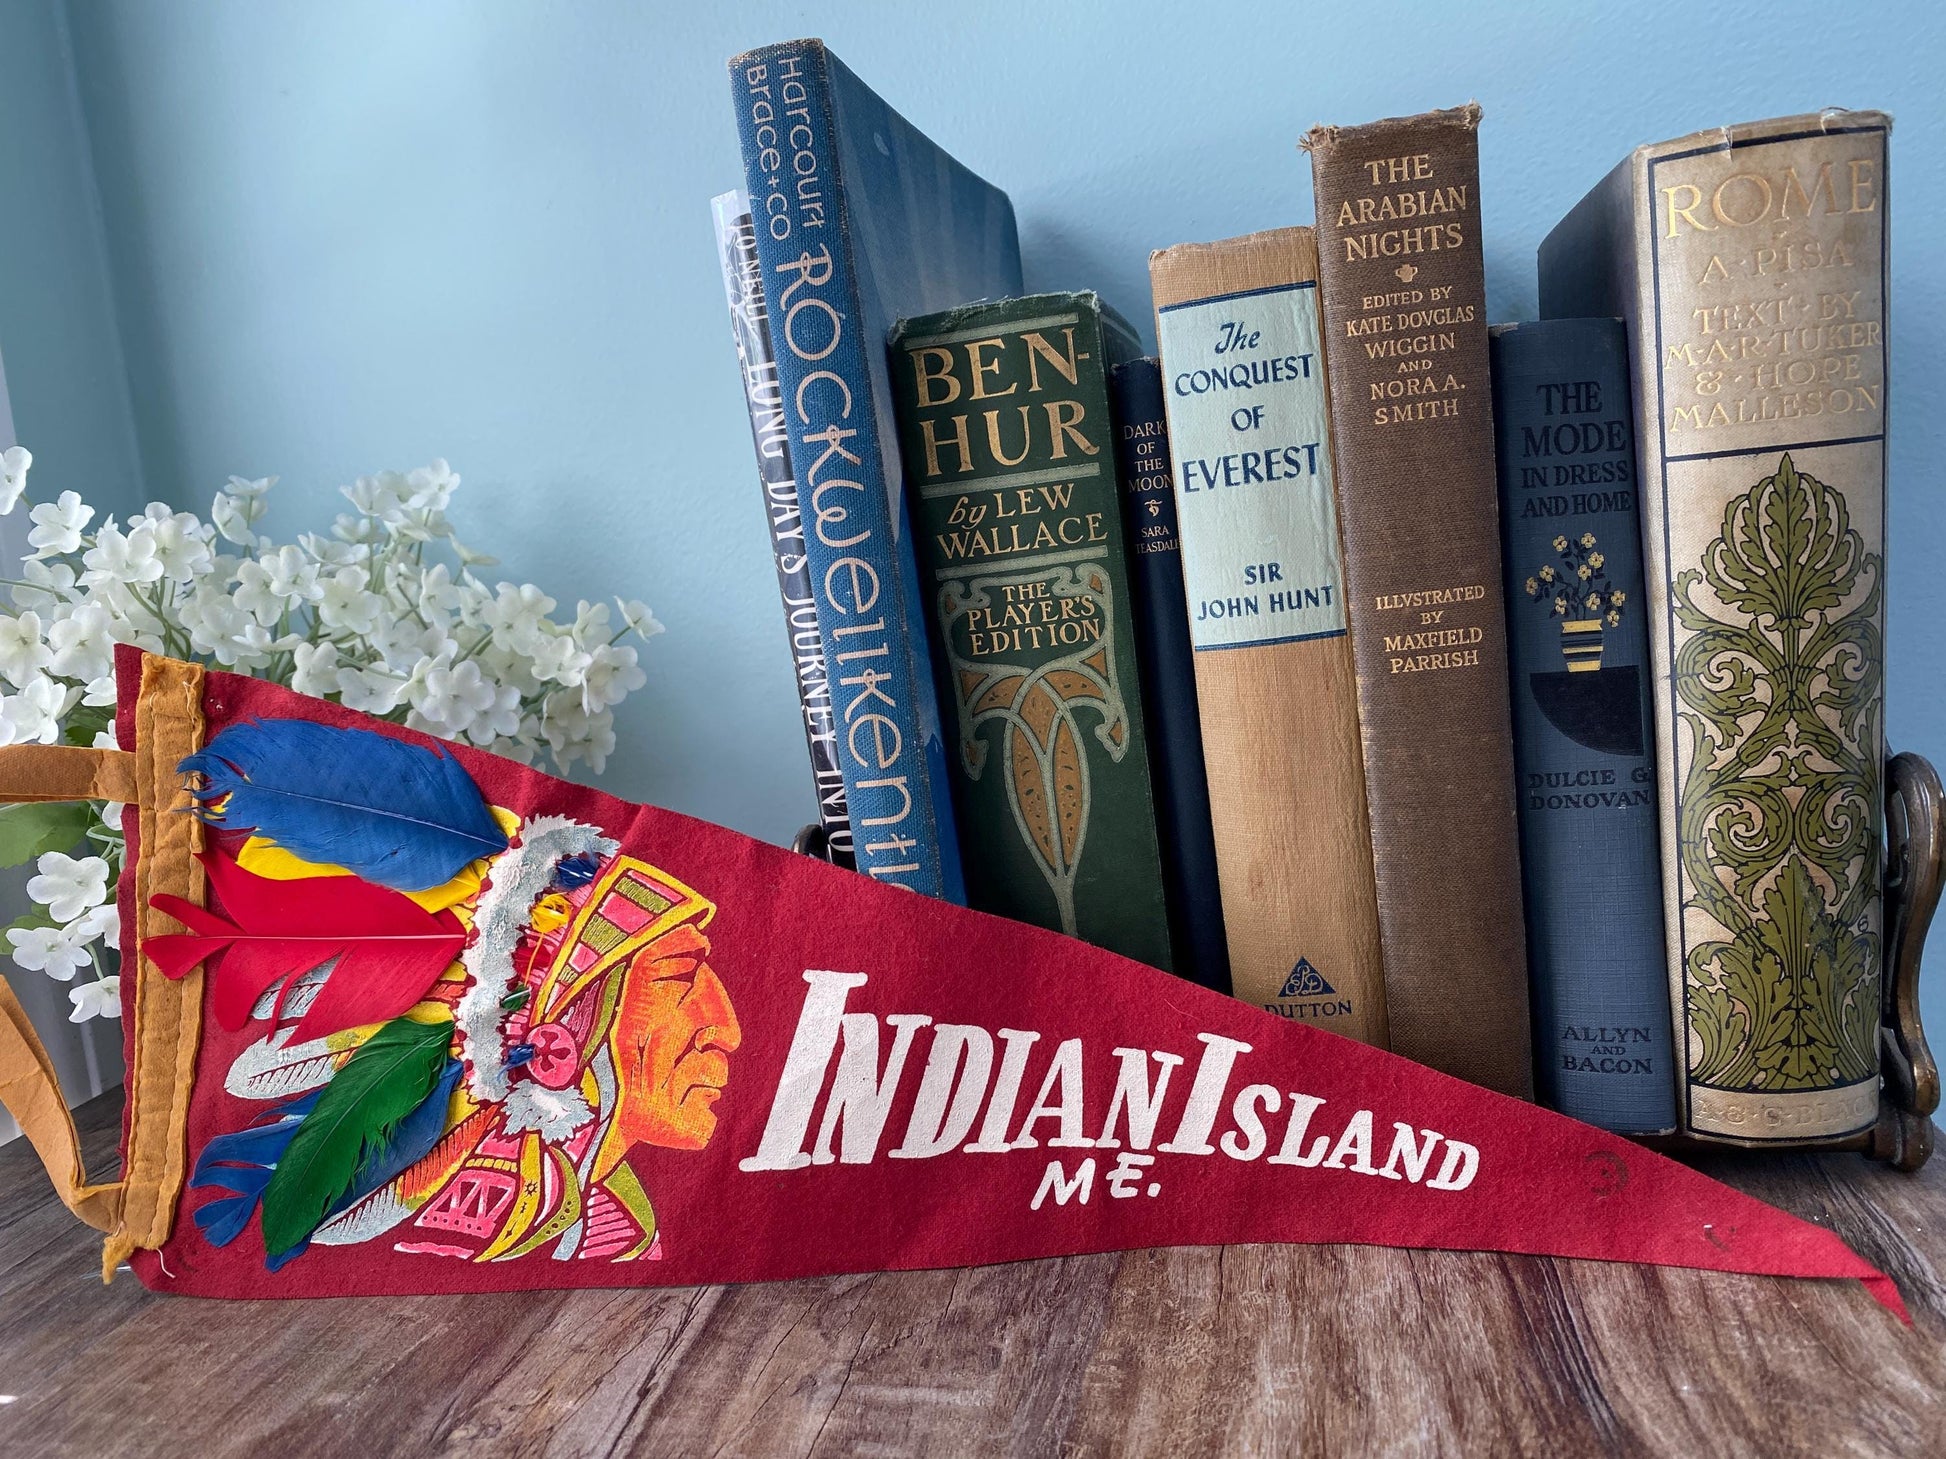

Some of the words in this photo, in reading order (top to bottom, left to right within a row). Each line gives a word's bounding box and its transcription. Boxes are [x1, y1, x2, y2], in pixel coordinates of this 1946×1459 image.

[778, 56, 825, 228] Harcourt
[1364, 153, 1434, 186] THE
[1335, 185, 1468, 228] ARABIAN
[1661, 158, 1878, 240] ROME
[1343, 223, 1464, 263] NIGHTS
[1362, 290, 1424, 311] EDITED
[1429, 285, 1453, 302] BY
[1346, 314, 1393, 338] KATE
[1692, 297, 1795, 335] TEXT
[1818, 290, 1862, 321] BY
[1214, 321, 1261, 354] The
[1364, 332, 1456, 360] WIGGIN
[908, 327, 1090, 408] BEN-
[1174, 353, 1314, 397] CONQUEST
[1397, 359, 1433, 374] AND
[1694, 370, 1726, 396] &
[1750, 355, 1862, 391] HOPE
[1370, 375, 1438, 401] NORA
[1443, 371, 1467, 390] A.
[1536, 381, 1603, 416] THE
[1231, 404, 1265, 432] OF
[1374, 399, 1460, 426] SMITH
[1669, 385, 1880, 433] MALLESON
[919, 400, 1100, 477] HUR
[1123, 420, 1167, 440] DARK
[1521, 420, 1627, 458] MODE
[1136, 442, 1156, 455] OF
[1134, 457, 1165, 474] THE
[1181, 442, 1321, 494] EVEREST
[1520, 466, 1549, 489] IN
[1553, 460, 1629, 487] DRESS
[1128, 474, 1174, 493] MOON
[947, 496, 987, 529] by
[993, 483, 1075, 519] LEW
[1520, 495, 1568, 518] AND
[1571, 490, 1632, 515] HOME
[936, 513, 1108, 560] WALLACE
[1141, 525, 1170, 538] SARA
[1244, 562, 1284, 586] SIR
[1001, 582, 1051, 602] THE
[1197, 597, 1260, 622] JOHN
[1269, 584, 1334, 612] HUNT
[966, 594, 1097, 632] PLAYER'S
[1420, 610, 1444, 625] BY
[970, 618, 1101, 657] EDITION
[1383, 627, 1483, 652] MAXFIELD
[1390, 650, 1479, 674] PARRISH
[1528, 769, 1617, 789] DULCIE
[1529, 789, 1651, 811] DONOVAN
[1561, 1026, 1653, 1043] ALLYN
[1561, 1055, 1654, 1074] BACON
[1590, 1045, 1627, 1056] AND
